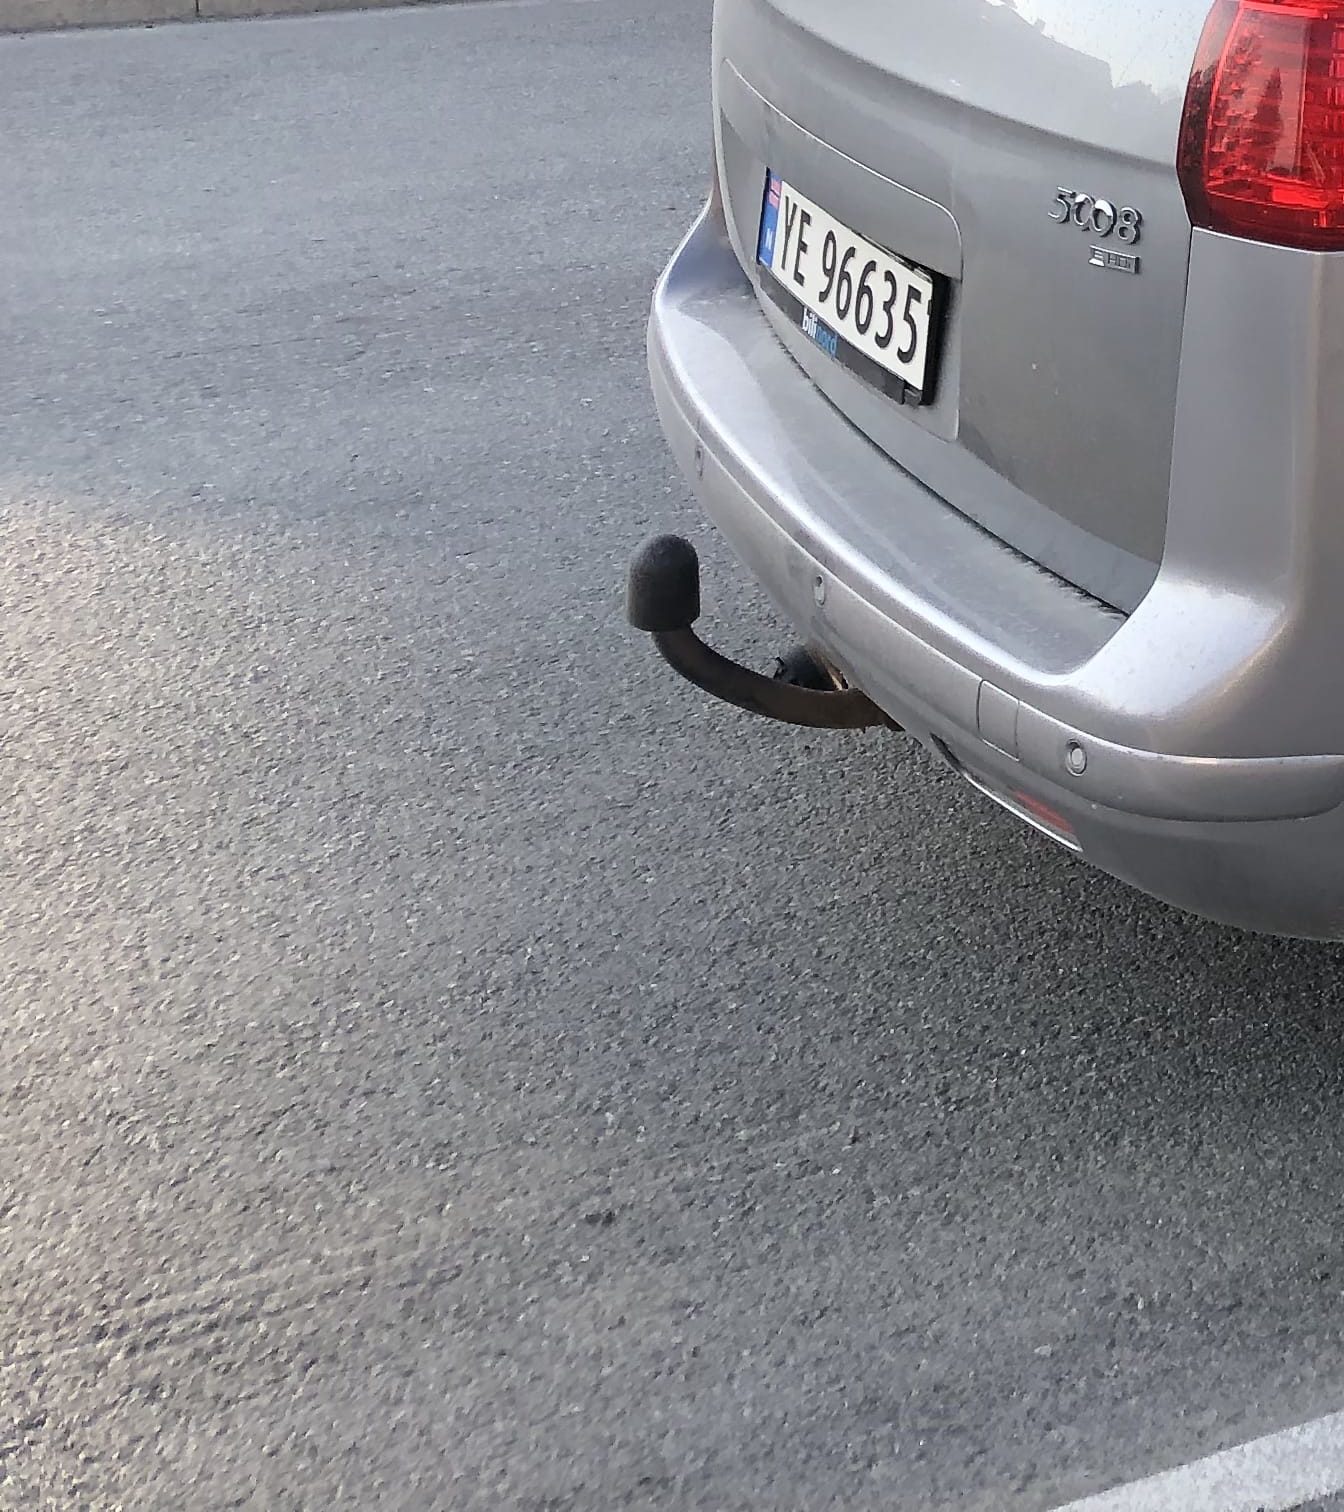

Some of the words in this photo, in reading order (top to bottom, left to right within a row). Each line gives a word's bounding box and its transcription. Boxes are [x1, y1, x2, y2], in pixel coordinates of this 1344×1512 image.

[1048, 185, 1141, 244] 5008
[781, 195, 812, 287] YE
[818, 229, 922, 364] 96635
